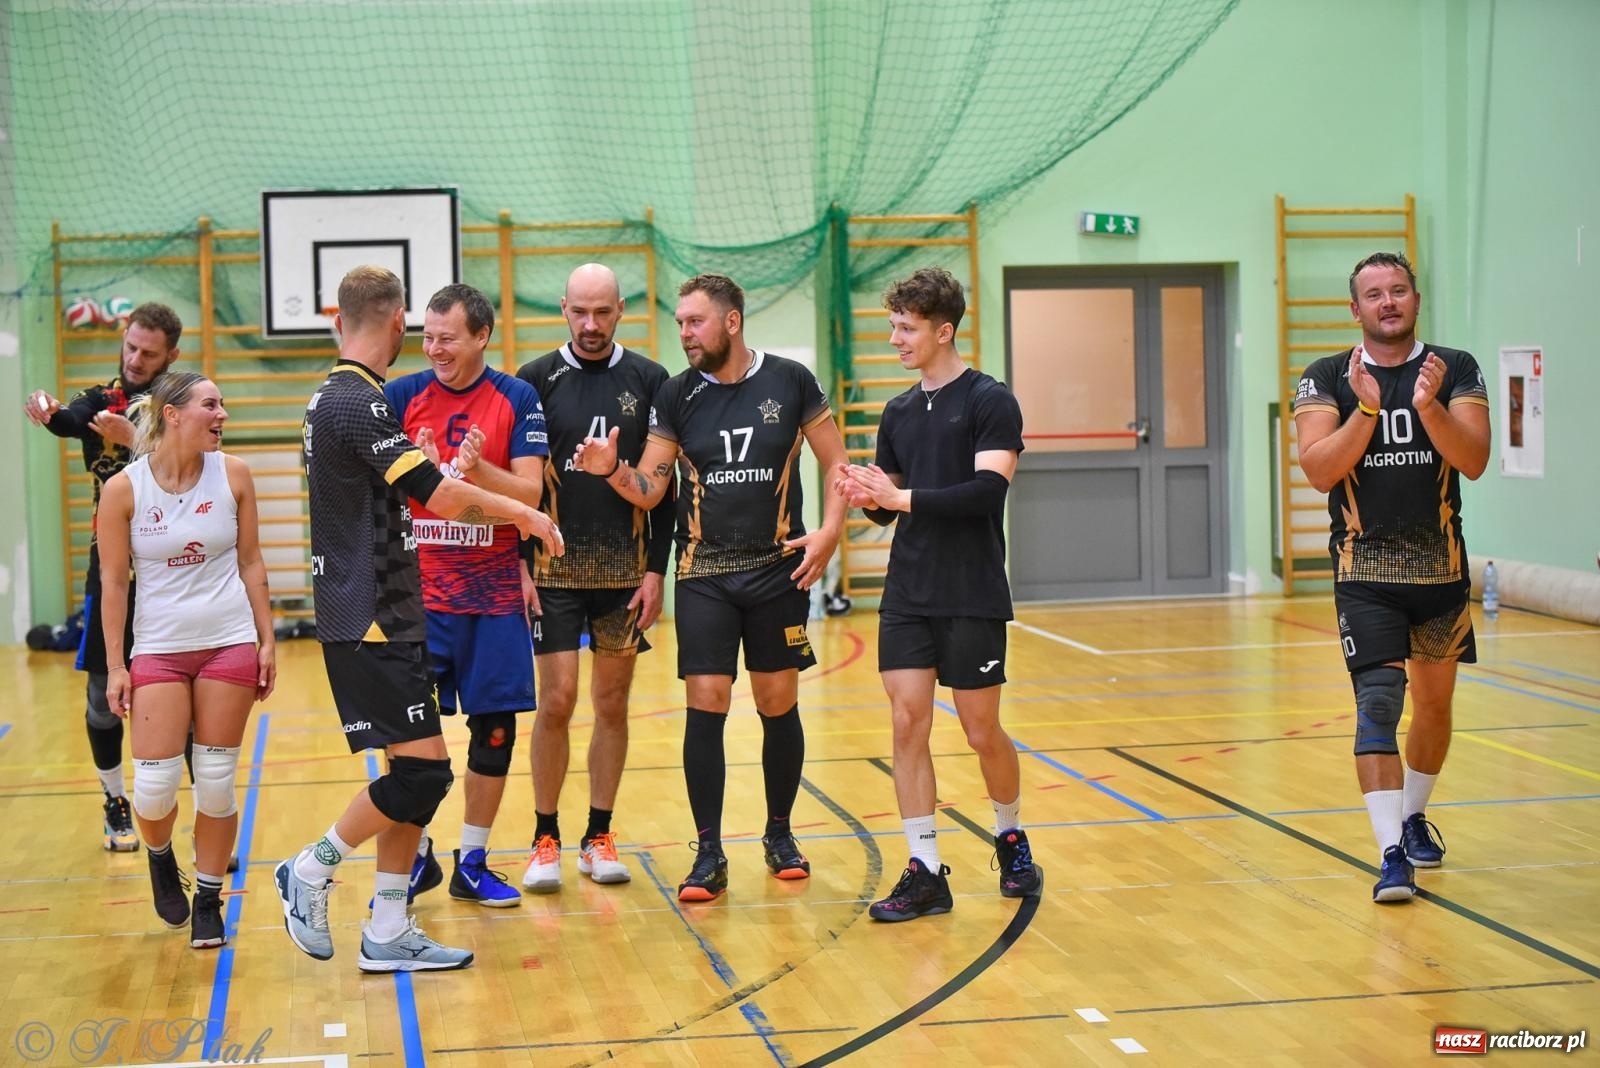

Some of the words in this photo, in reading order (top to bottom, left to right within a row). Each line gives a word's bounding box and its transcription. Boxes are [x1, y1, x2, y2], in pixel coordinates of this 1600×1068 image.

[446, 413, 469, 448] 6
[587, 416, 609, 446] 4
[1379, 408, 1413, 444] 10
[719, 426, 754, 464] 17
[1363, 451, 1433, 468] AGROTIM
[705, 468, 773, 485] AGROTIM
[139, 525, 168, 534] POLAND
[169, 555, 204, 566] ORLEN
[534, 621, 543, 641] 4
